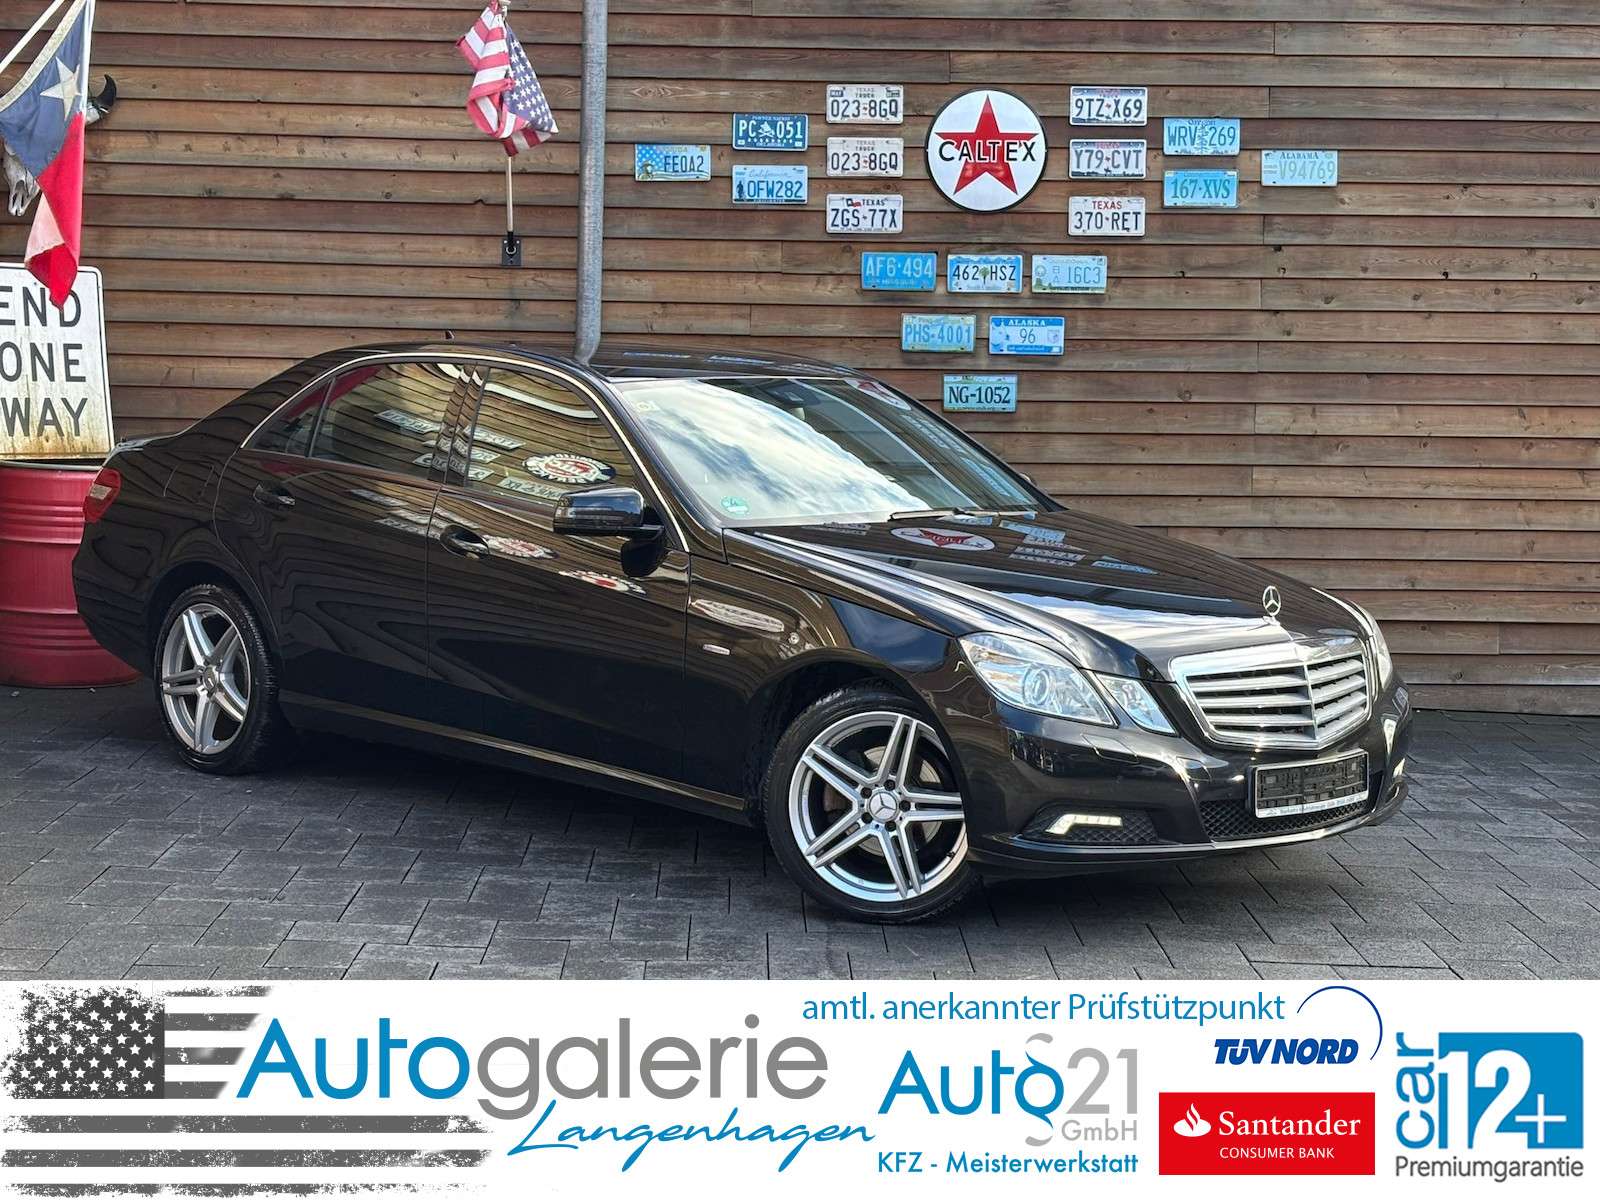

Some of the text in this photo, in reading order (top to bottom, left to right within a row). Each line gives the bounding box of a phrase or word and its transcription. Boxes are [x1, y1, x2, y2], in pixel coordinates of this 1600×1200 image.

[1167, 126, 1236, 147] WRV 269
[938, 139, 1037, 163] CALTEX
[862, 198, 886, 207] TEXAS
[1092, 200, 1122, 210] TEXAS
[1008, 319, 1046, 327] ALASKA
[1019, 327, 1036, 344] 96
[0, 341, 86, 383] ONE
[948, 386, 1011, 404] NG-1052
[0, 397, 88, 437] WAY
